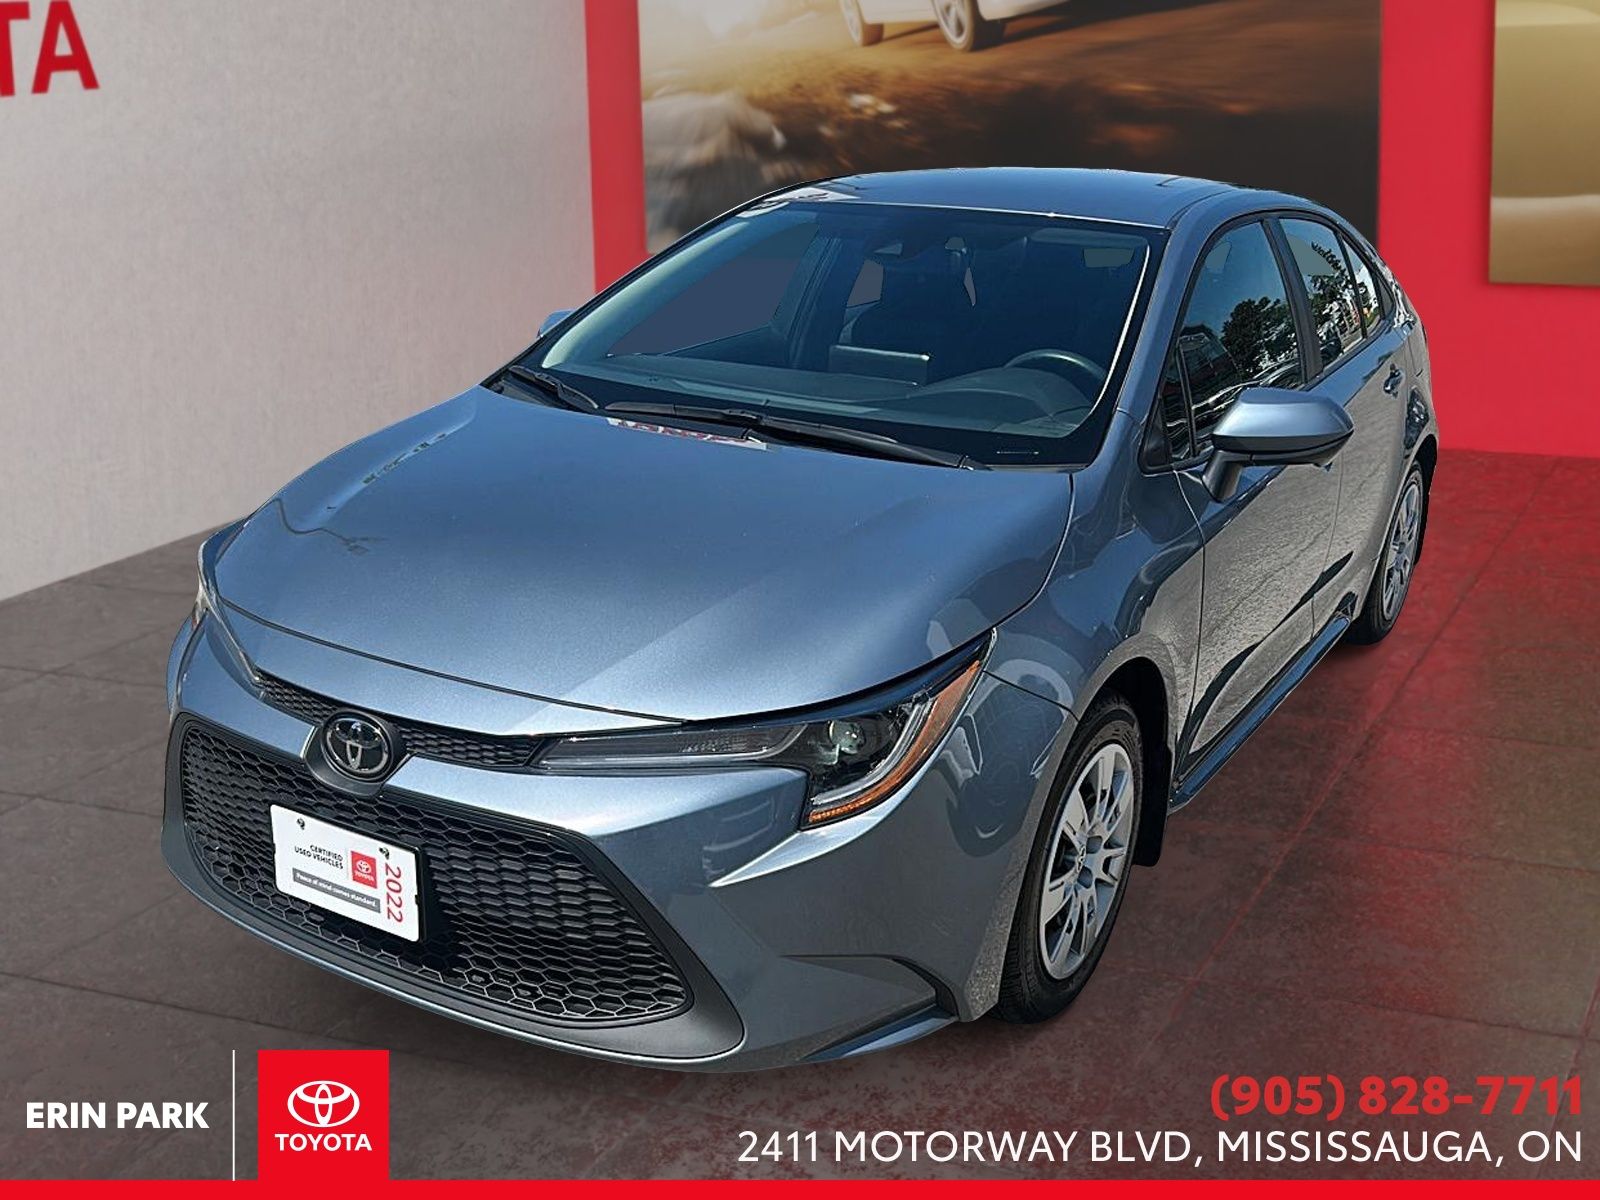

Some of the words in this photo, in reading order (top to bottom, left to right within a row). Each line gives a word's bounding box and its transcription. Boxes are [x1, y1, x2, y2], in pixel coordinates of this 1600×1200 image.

[294, 845, 312, 858] USED
[312, 852, 344, 870] VEHICLES
[309, 844, 344, 862] CERTIFIED
[385, 862, 404, 923] 2022
